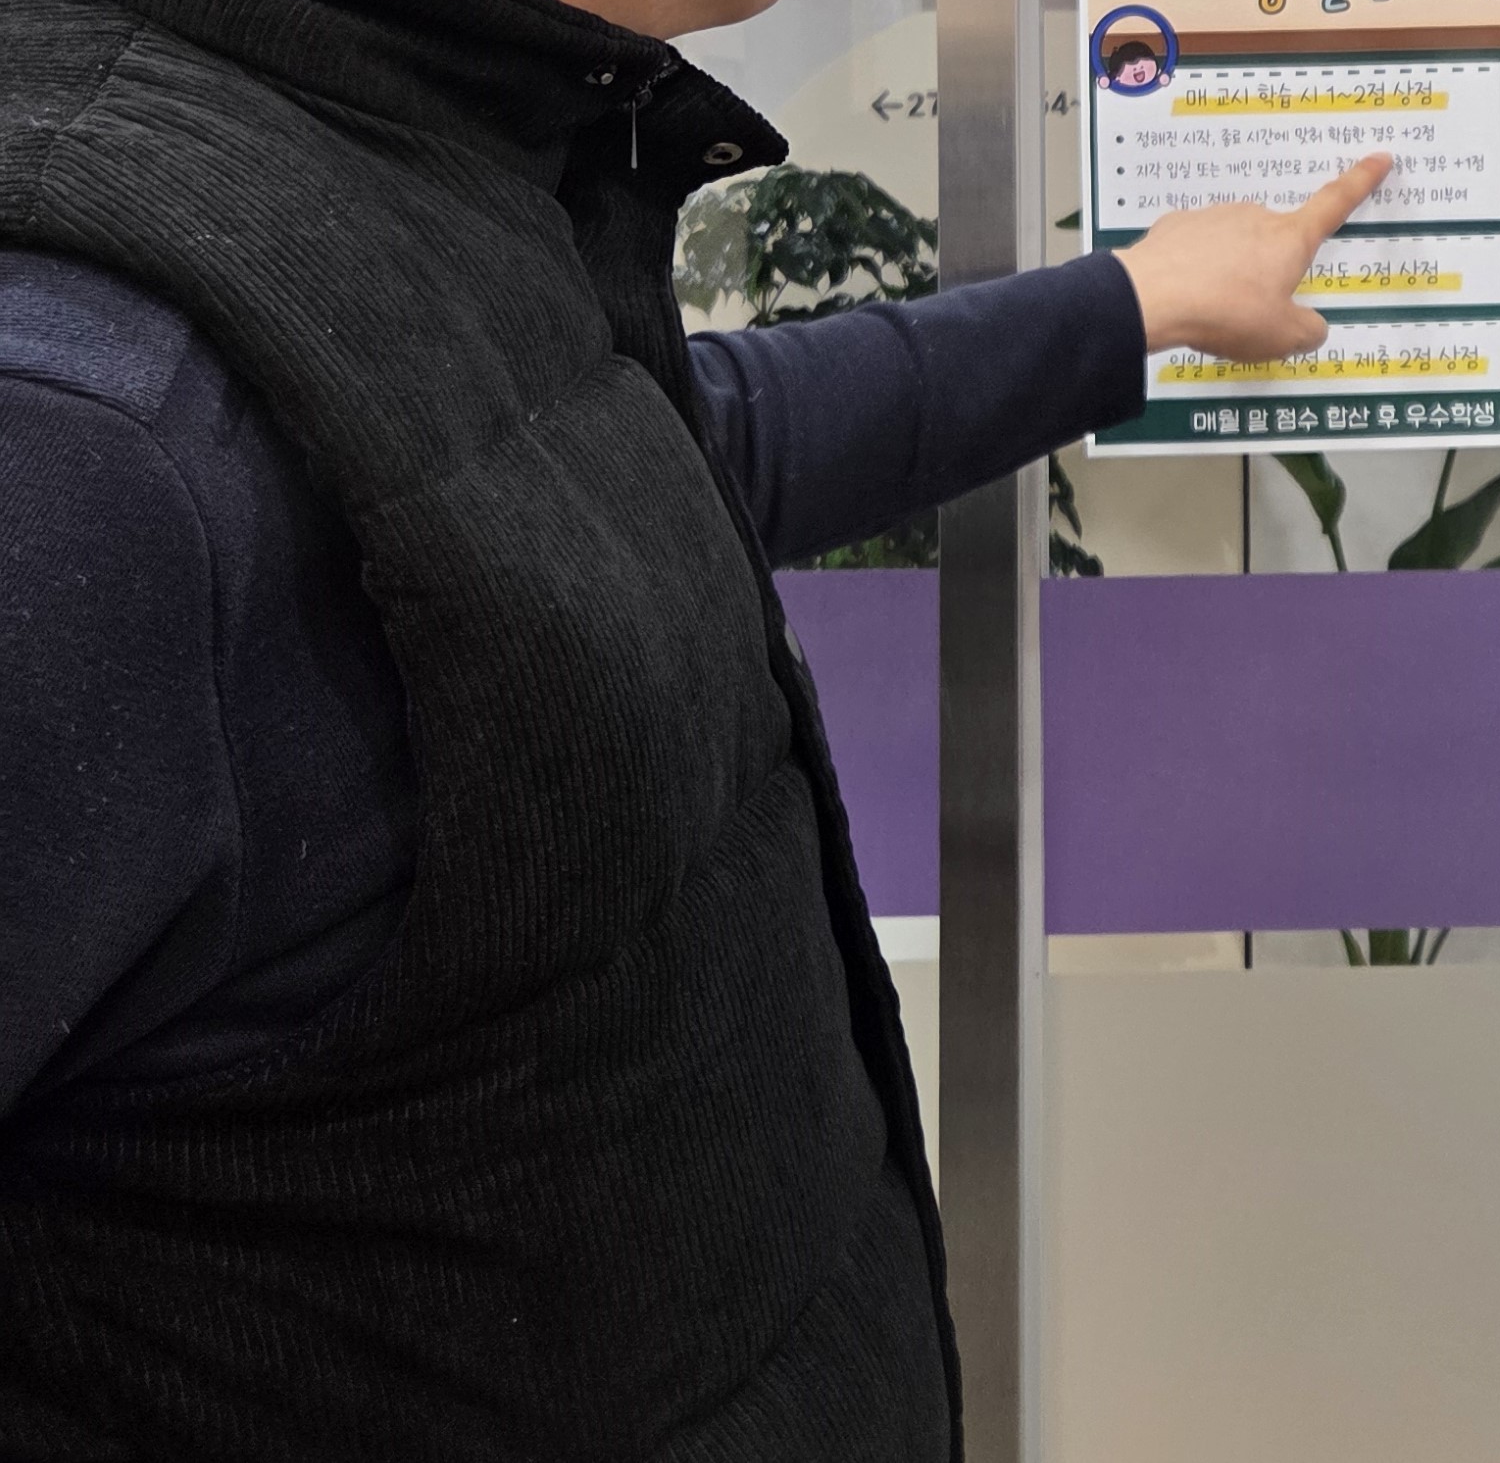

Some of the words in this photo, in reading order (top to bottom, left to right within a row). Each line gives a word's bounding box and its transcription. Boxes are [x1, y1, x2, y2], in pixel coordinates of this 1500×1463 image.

[1186, 88, 1207, 106] 매
[1216, 87, 1249, 106] 교시
[1257, 82, 1292, 109] 학습
[1300, 85, 1318, 103] 시
[1326, 81, 1386, 106] 1~2점
[1393, 80, 1432, 106] 상점
[1136, 129, 1178, 148] 정해진
[1183, 129, 1216, 148] 시작,
[1222, 128, 1242, 148] 종료
[1247, 127, 1290, 146] 시간에
[1295, 125, 1323, 145] 맞춰
[1328, 125, 1365, 144] 학습한
[1371, 125, 1395, 143] 경우
[1401, 124, 1435, 142] +2점
[1136, 161, 1161, 179] 지각
[1166, 160, 1191, 179] 입실
[1197, 161, 1221, 178] 또는
[1226, 160, 1252, 178] 개인
[1257, 158, 1302, 177] 일정으로
[1307, 159, 1330, 174] 교시
[1422, 154, 1447, 173] 경우
[1454, 154, 1485, 173] +1점
[1138, 194, 1160, 210] 교시
[1166, 191, 1203, 210] 학습이
[1371, 187, 1393, 205] 경우
[1398, 187, 1426, 206] 상점
[1431, 187, 1468, 204] 미부여
[1360, 261, 1391, 286] 2점
[1400, 259, 1438, 285] 상점
[1170, 351, 1203, 379] 일일
[1328, 348, 1345, 375] 및
[1354, 344, 1390, 375] 제출
[1399, 346, 1431, 372] 2점
[1439, 345, 1479, 371] 상점
[1193, 406, 1240, 434] 매월
[1248, 407, 1269, 433] 말
[1275, 405, 1319, 433] 점수
[1327, 404, 1370, 430] 합산
[1377, 403, 1399, 430] 후
[1406, 400, 1495, 428] 우수학생
